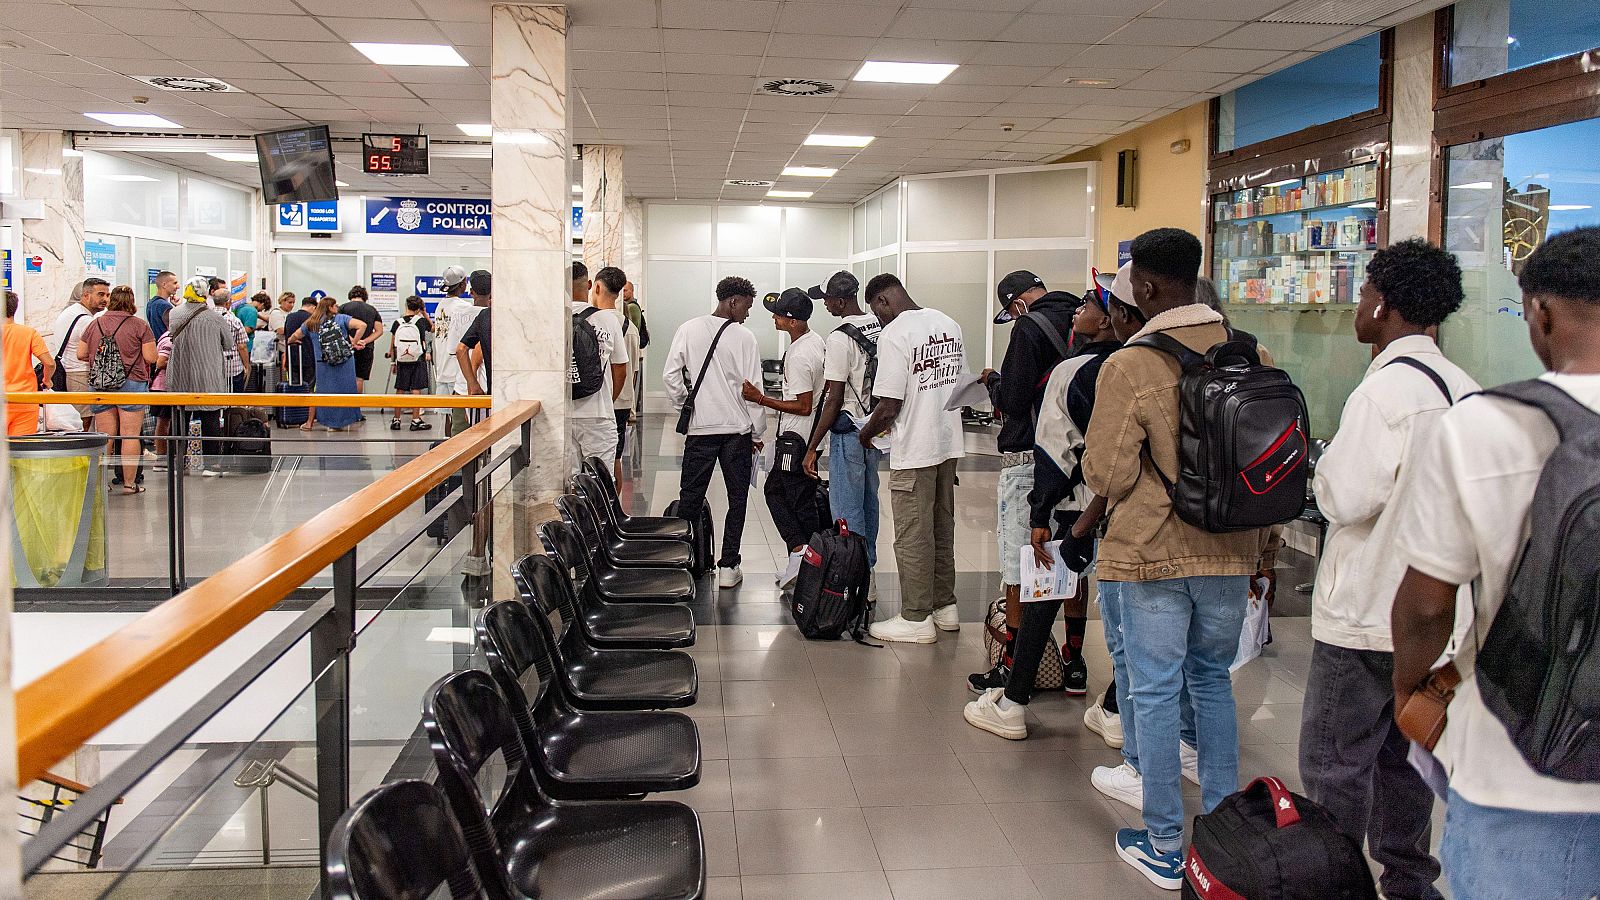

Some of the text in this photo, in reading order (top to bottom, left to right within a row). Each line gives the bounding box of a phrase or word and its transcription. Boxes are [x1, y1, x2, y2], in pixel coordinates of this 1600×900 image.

[391, 137, 401, 152] 5
[426, 203, 491, 215] CONTROL
[432, 215, 488, 229] POLICÍA
[928, 332, 955, 346] ALL
[912, 357, 940, 375] ARE
